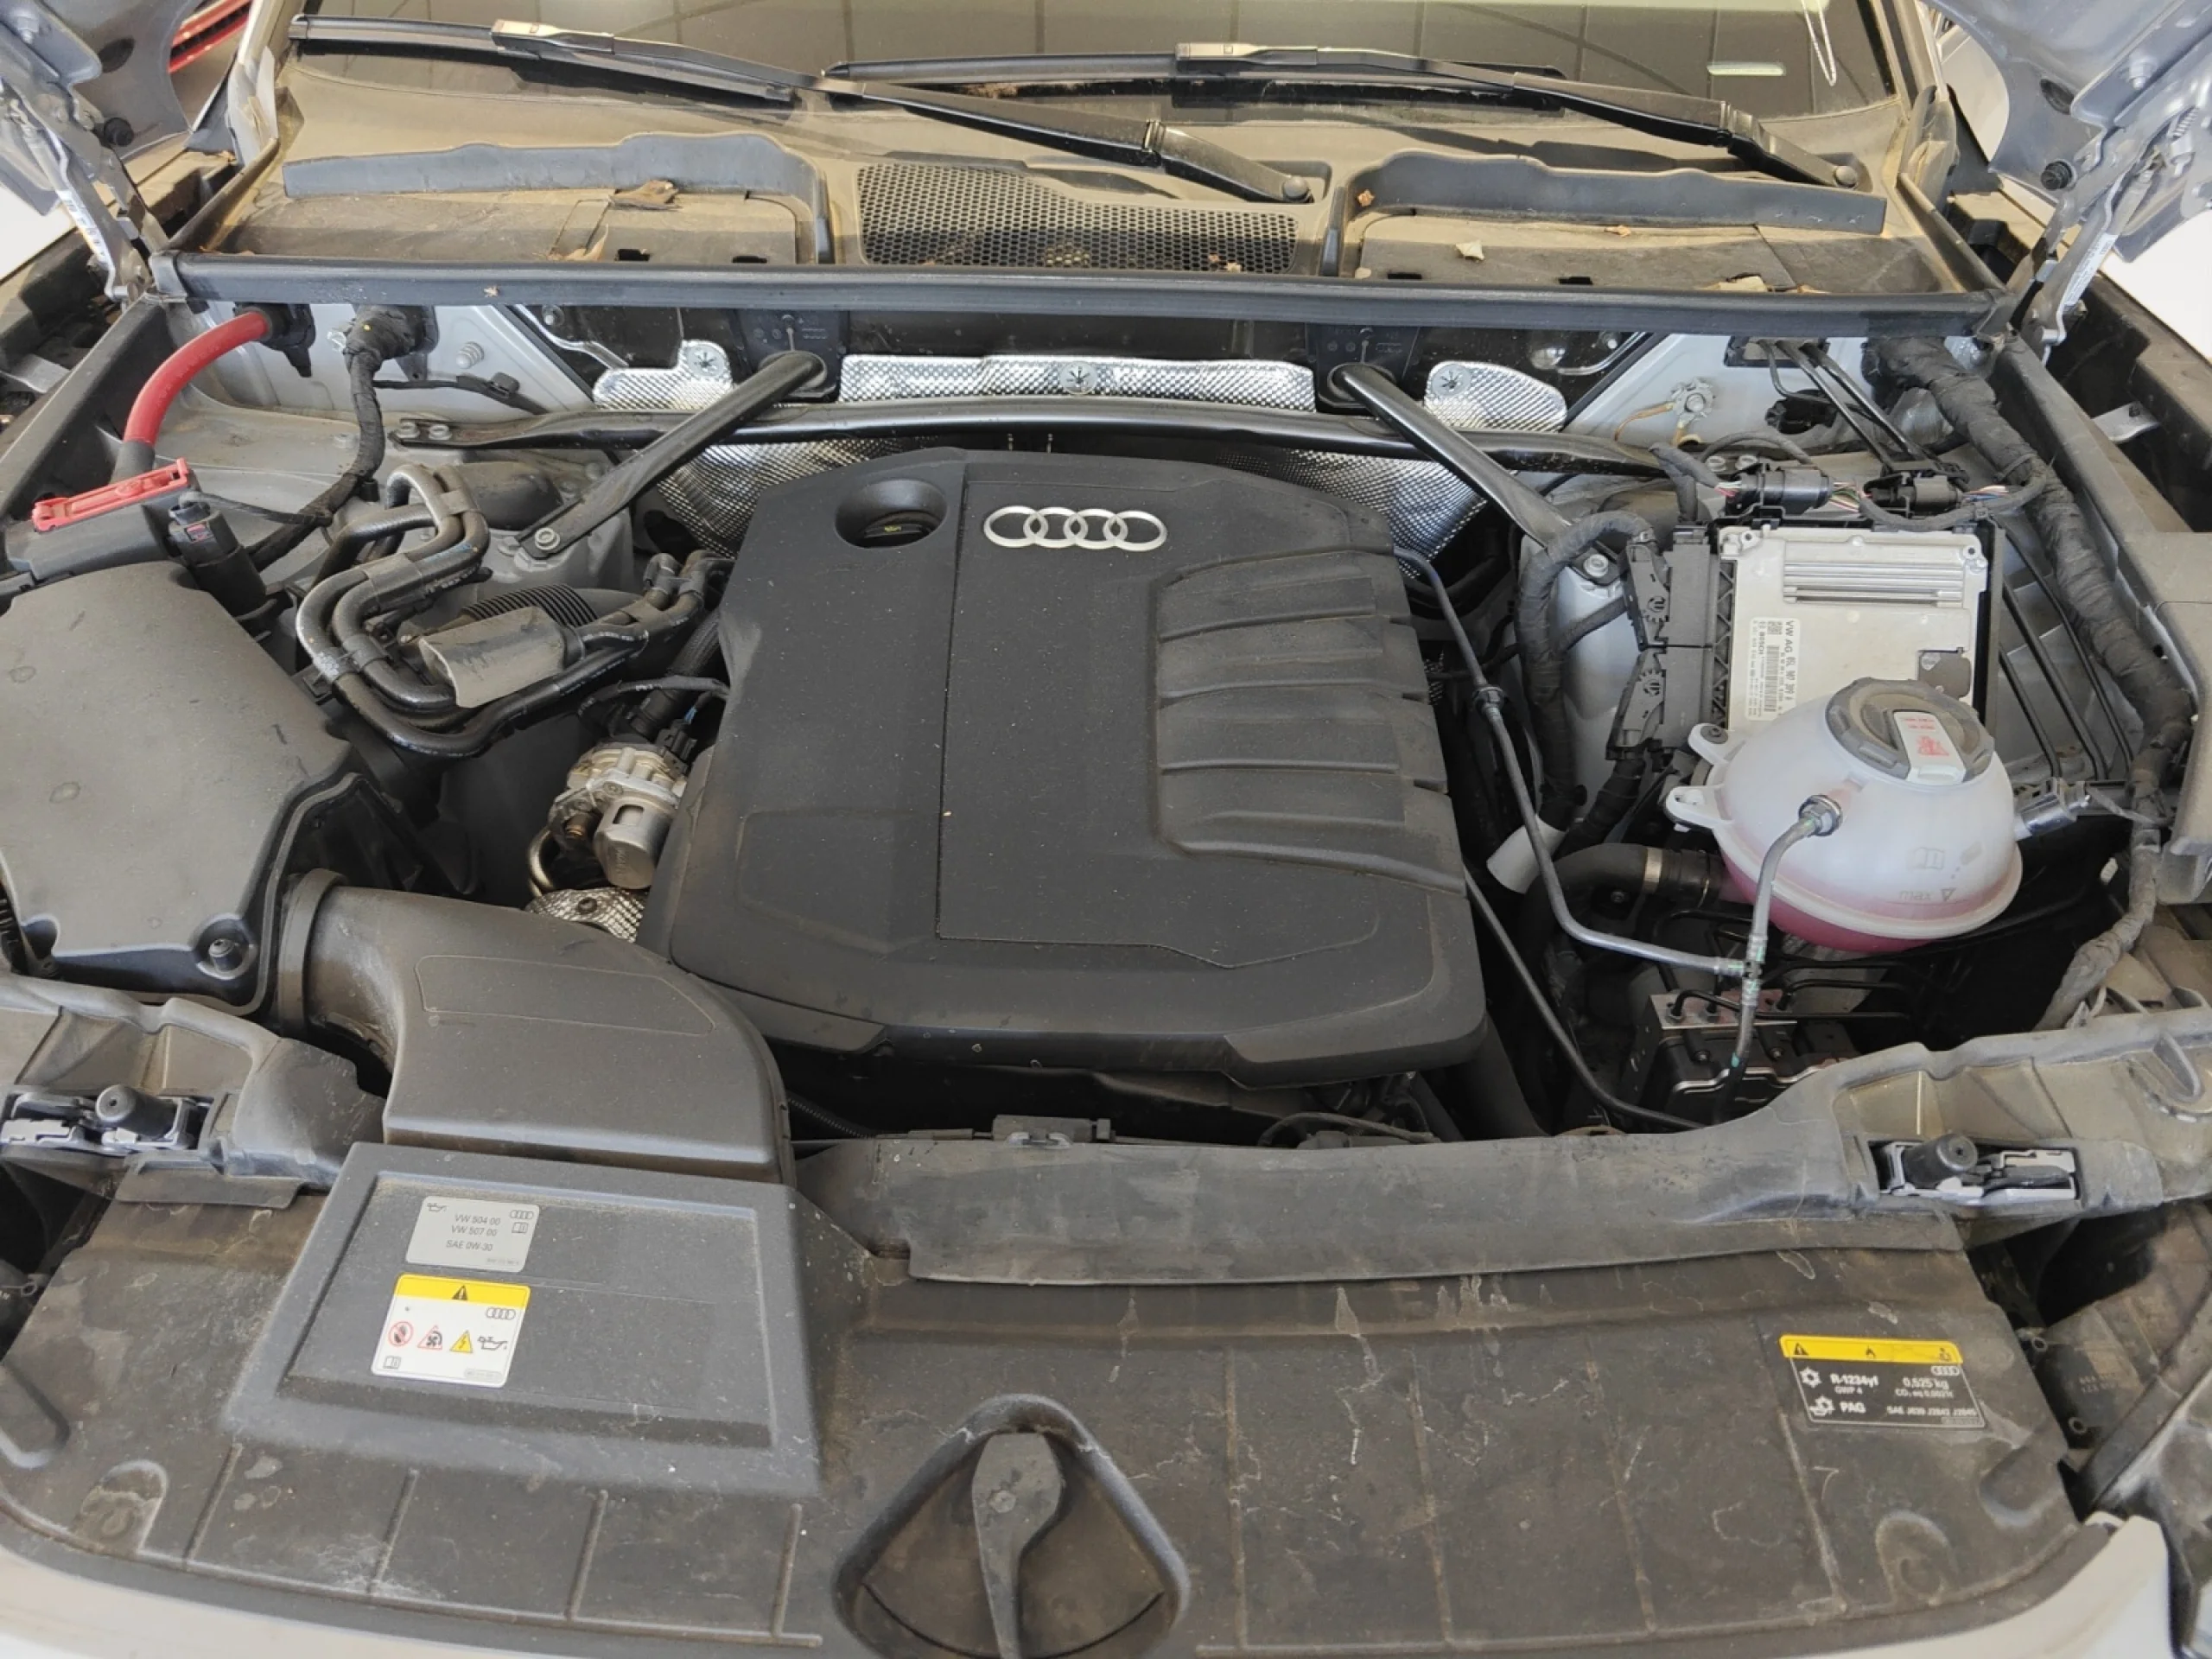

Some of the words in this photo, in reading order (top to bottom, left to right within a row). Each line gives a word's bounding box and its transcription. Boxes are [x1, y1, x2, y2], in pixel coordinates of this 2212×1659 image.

[1785, 620, 1795, 636] VW
[1784, 639, 1793, 653] AG
[454, 1213, 472, 1224] VW
[473, 1216, 488, 1224] 504
[451, 1224, 467, 1233] VW
[486, 1228, 498, 1236] 00
[446, 1239, 464, 1249] SAE
[1840, 1402, 1866, 1414] PAG
